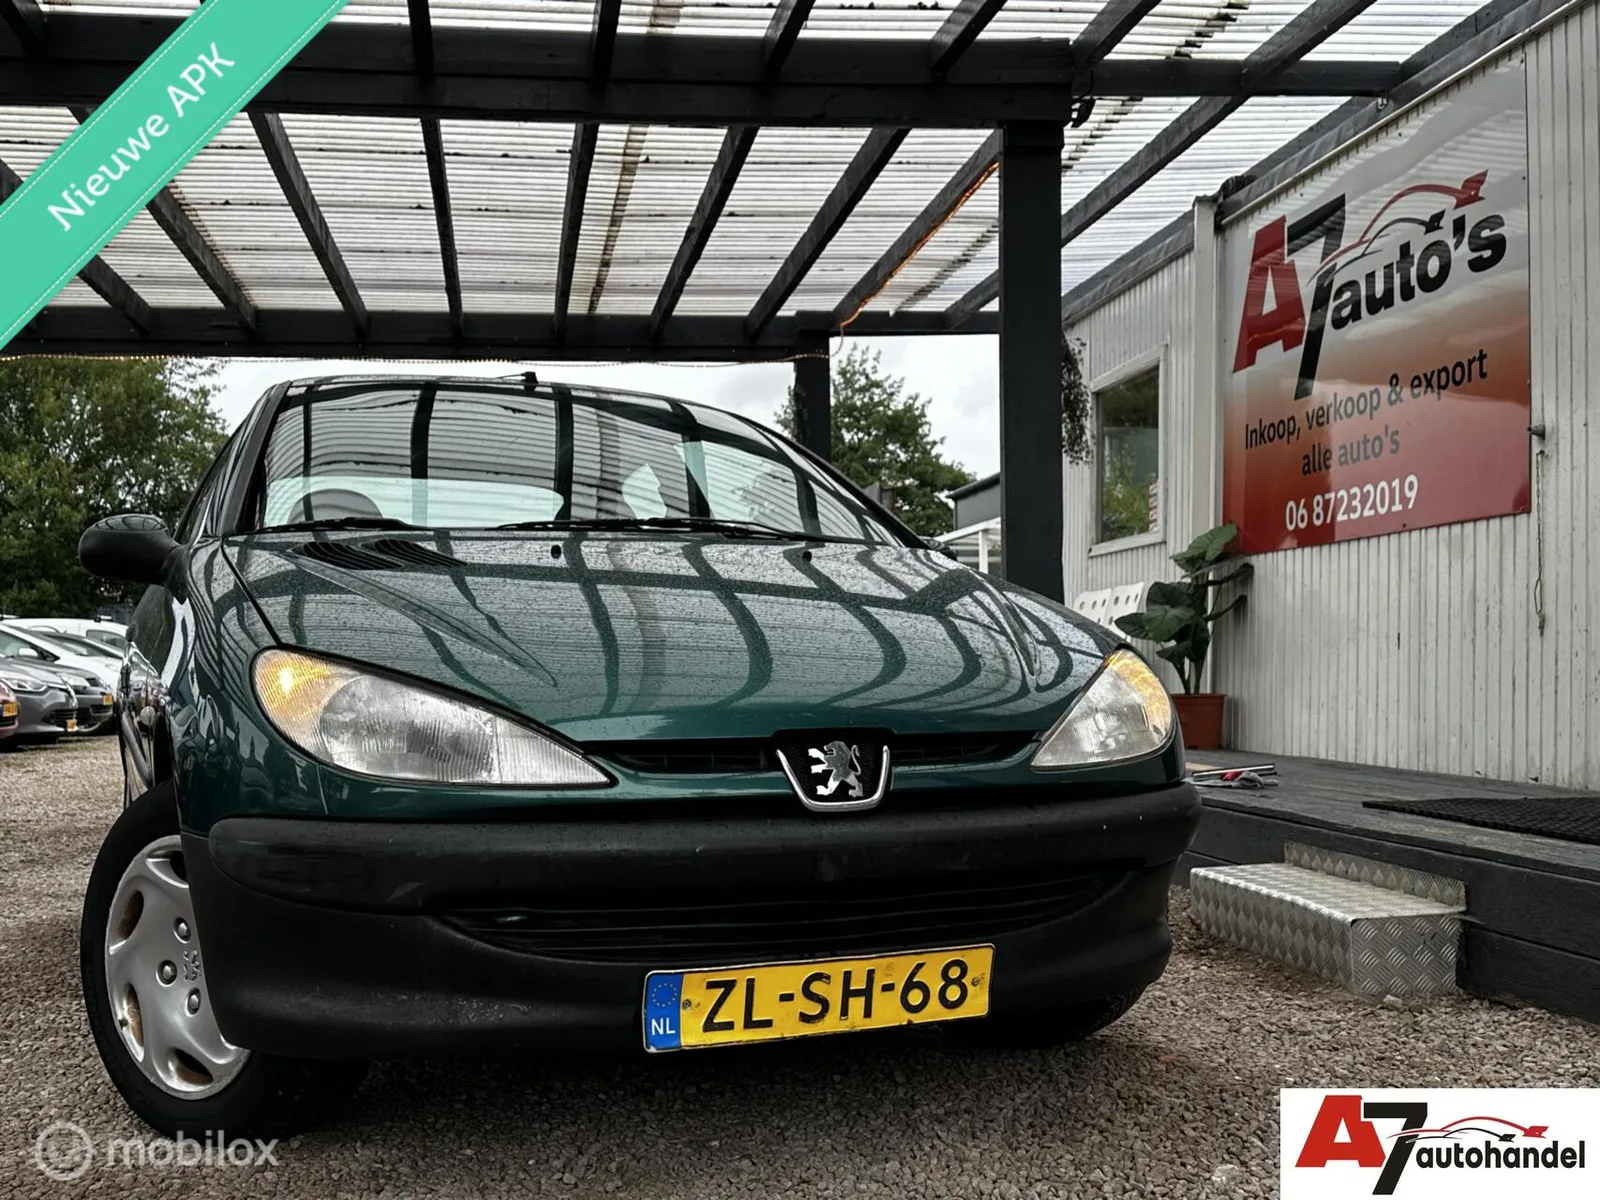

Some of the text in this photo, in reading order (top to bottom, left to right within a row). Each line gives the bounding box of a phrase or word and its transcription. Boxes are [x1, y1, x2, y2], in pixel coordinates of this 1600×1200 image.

[1233, 193, 1507, 400] A7 auto's
[1245, 349, 1488, 450] Inkoop, verkoop & export
[1302, 425, 1400, 475] alle auto's
[1285, 474, 1419, 531] 06 87232019
[651, 1018, 676, 1036] NL
[702, 958, 969, 1033] ZL-SH-68
